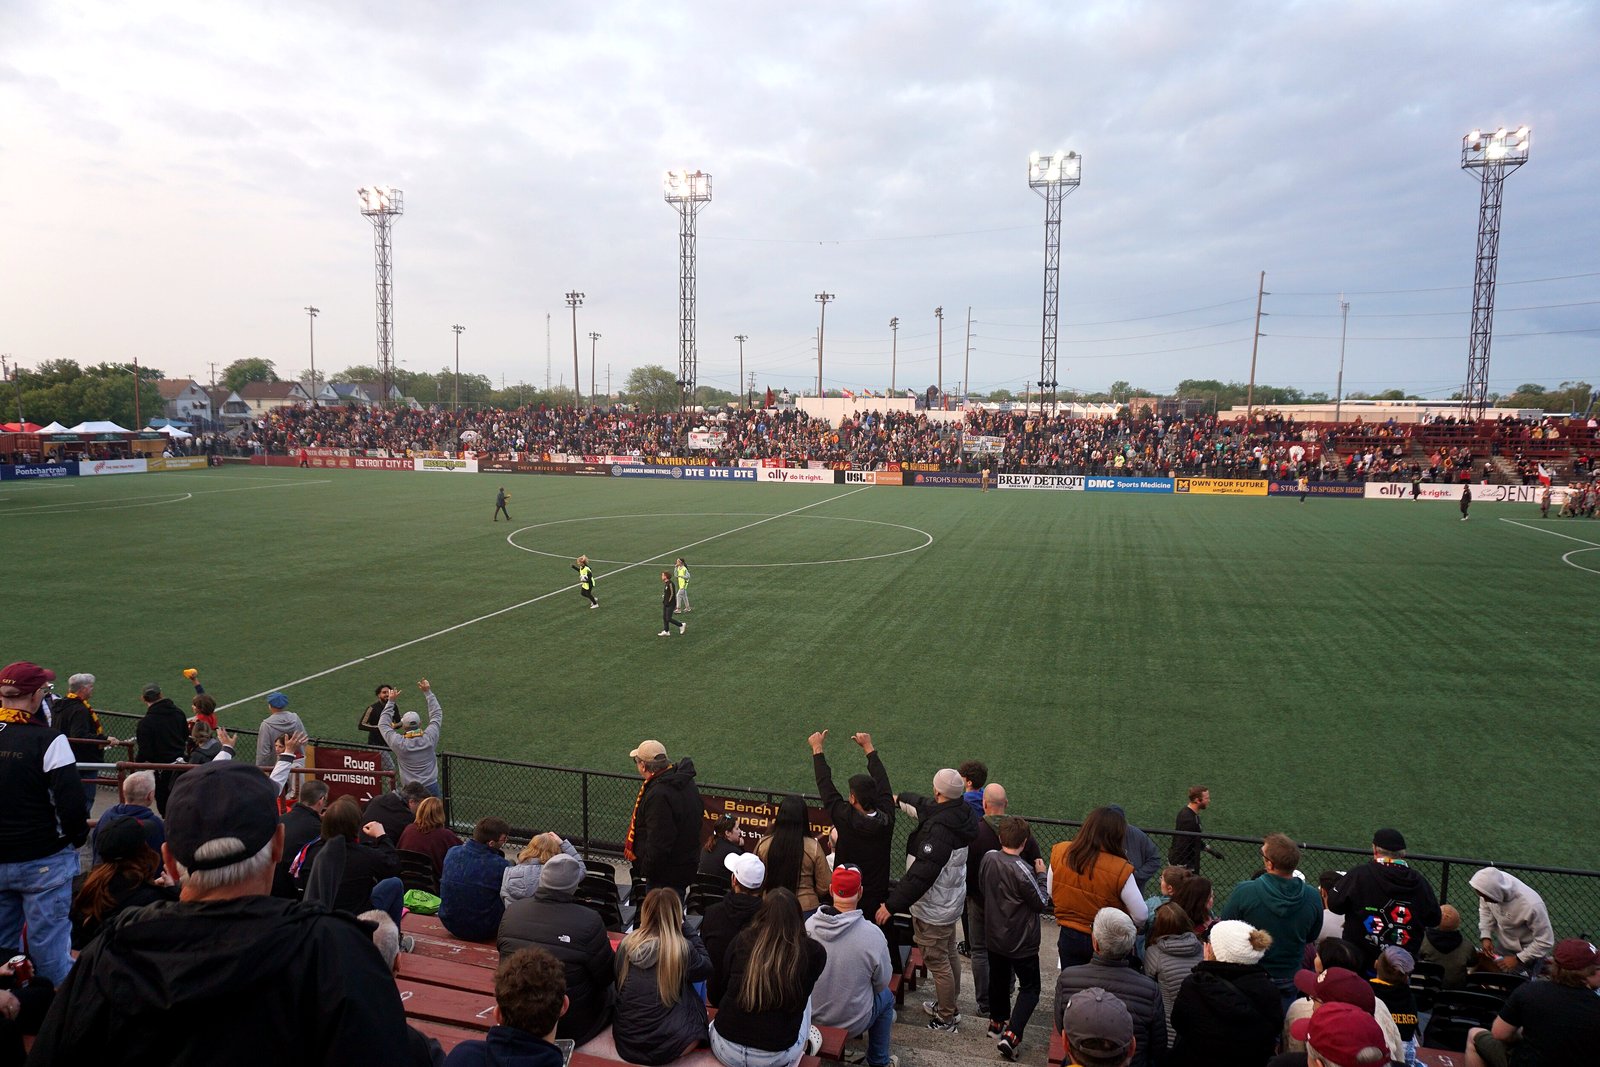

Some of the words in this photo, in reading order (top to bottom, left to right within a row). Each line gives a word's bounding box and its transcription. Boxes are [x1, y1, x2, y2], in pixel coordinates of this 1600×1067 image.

[355, 458, 383, 468] DETROIT
[385, 460, 401, 469] CITY
[403, 460, 413, 468] FC
[15, 466, 67, 476] Pontchartrain
[685, 468, 705, 477] DTE
[709, 469, 729, 478] DTE
[733, 469, 754, 479] DTE
[768, 469, 788, 481] ally
[805, 474, 824, 483] right.
[846, 472, 866, 483] USL
[998, 475, 1032, 485] BREW
[1033, 476, 1085, 487] DETROIT
[1088, 479, 1115, 488] DMC
[1117, 481, 1139, 489] Sports
[1140, 481, 1171, 489] Medicine
[1235, 480, 1265, 488] FUTURE
[1380, 484, 1406, 498] ally
[1428, 489, 1452, 497] right.
[344, 756, 375, 771] Rouge
[323, 773, 376, 786] Admission
[724, 800, 772, 816] Bench
